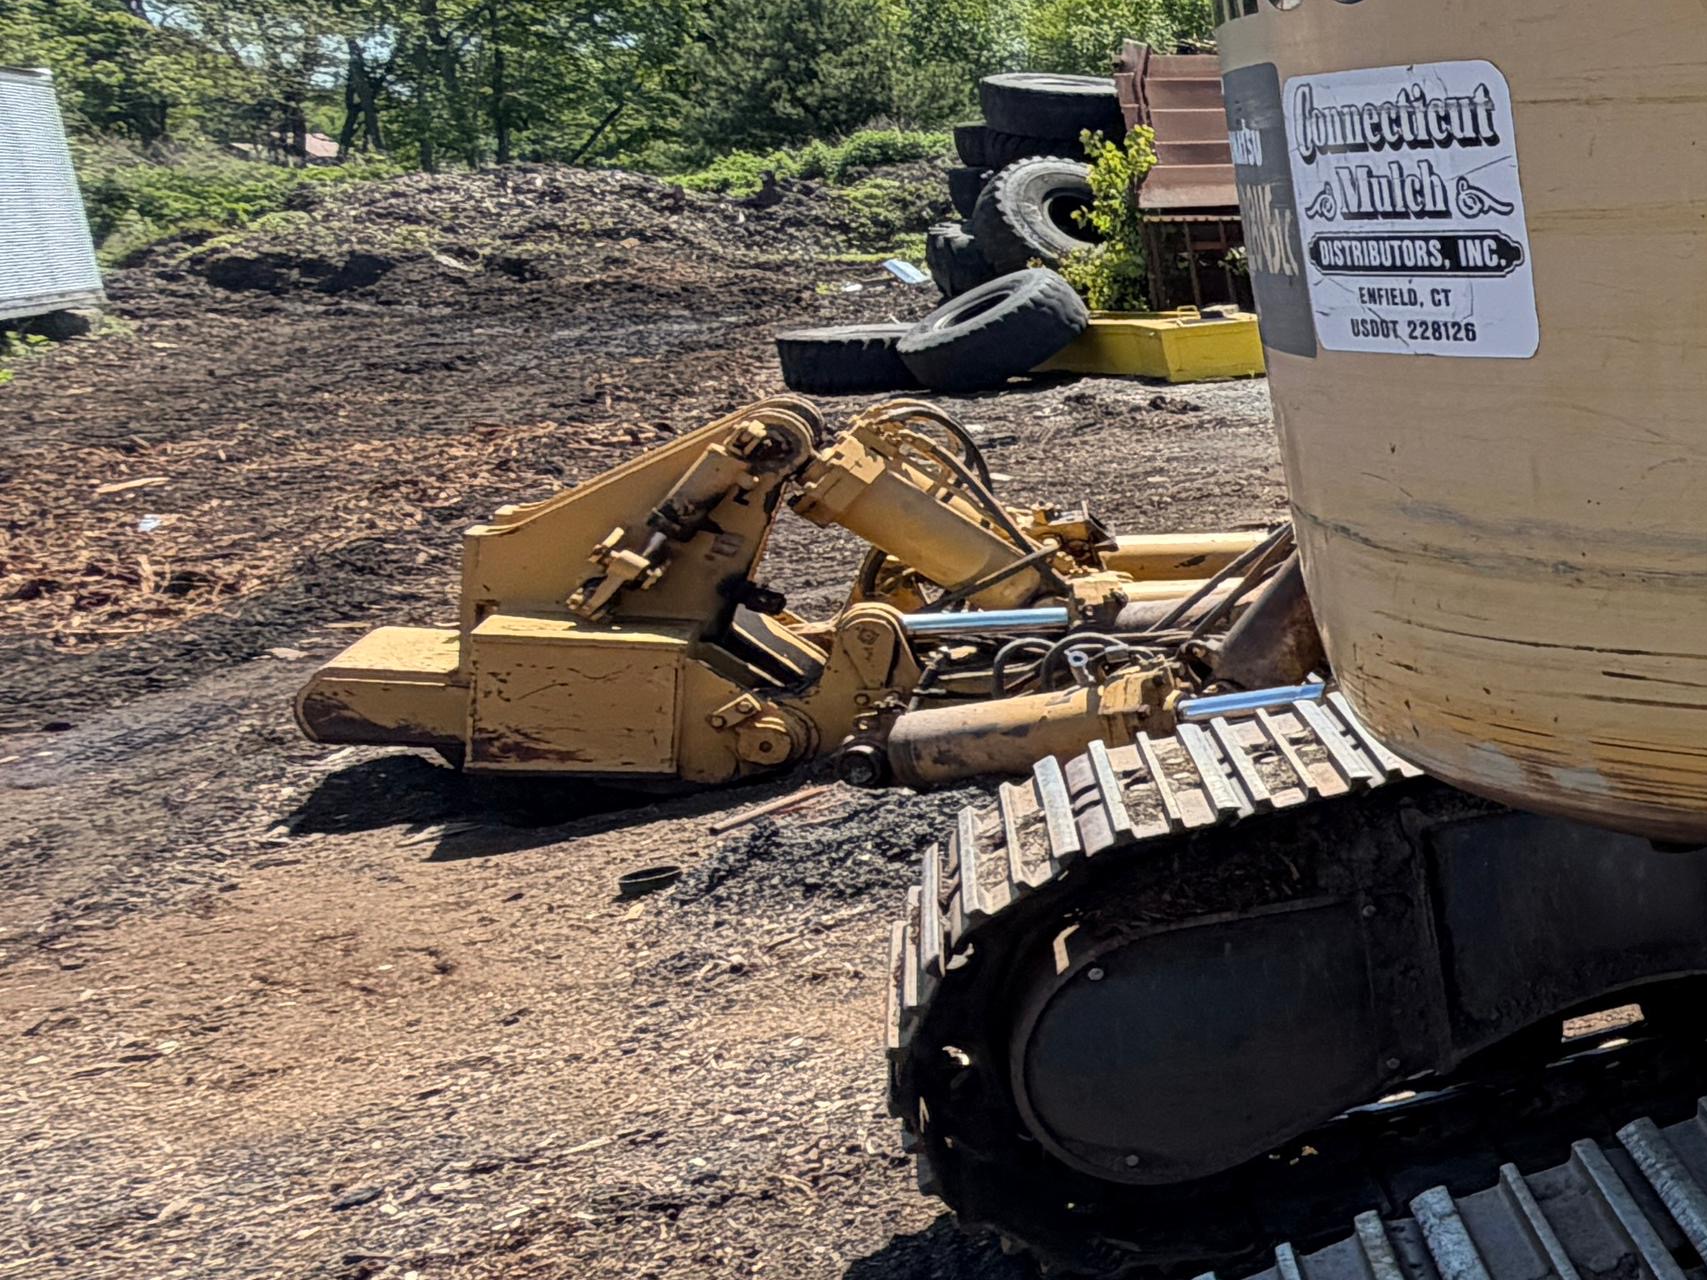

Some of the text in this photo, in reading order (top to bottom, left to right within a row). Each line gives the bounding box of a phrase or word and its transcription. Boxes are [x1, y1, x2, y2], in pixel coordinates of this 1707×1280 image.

[1294, 83, 1501, 165] Connecticut
[1335, 159, 1452, 220] Mulch
[1319, 238, 1508, 270] DISTRIBUTORS, INC.
[1358, 287, 1452, 308] ENFIELD, CT
[1350, 318, 1477, 342] USDOT 228126
